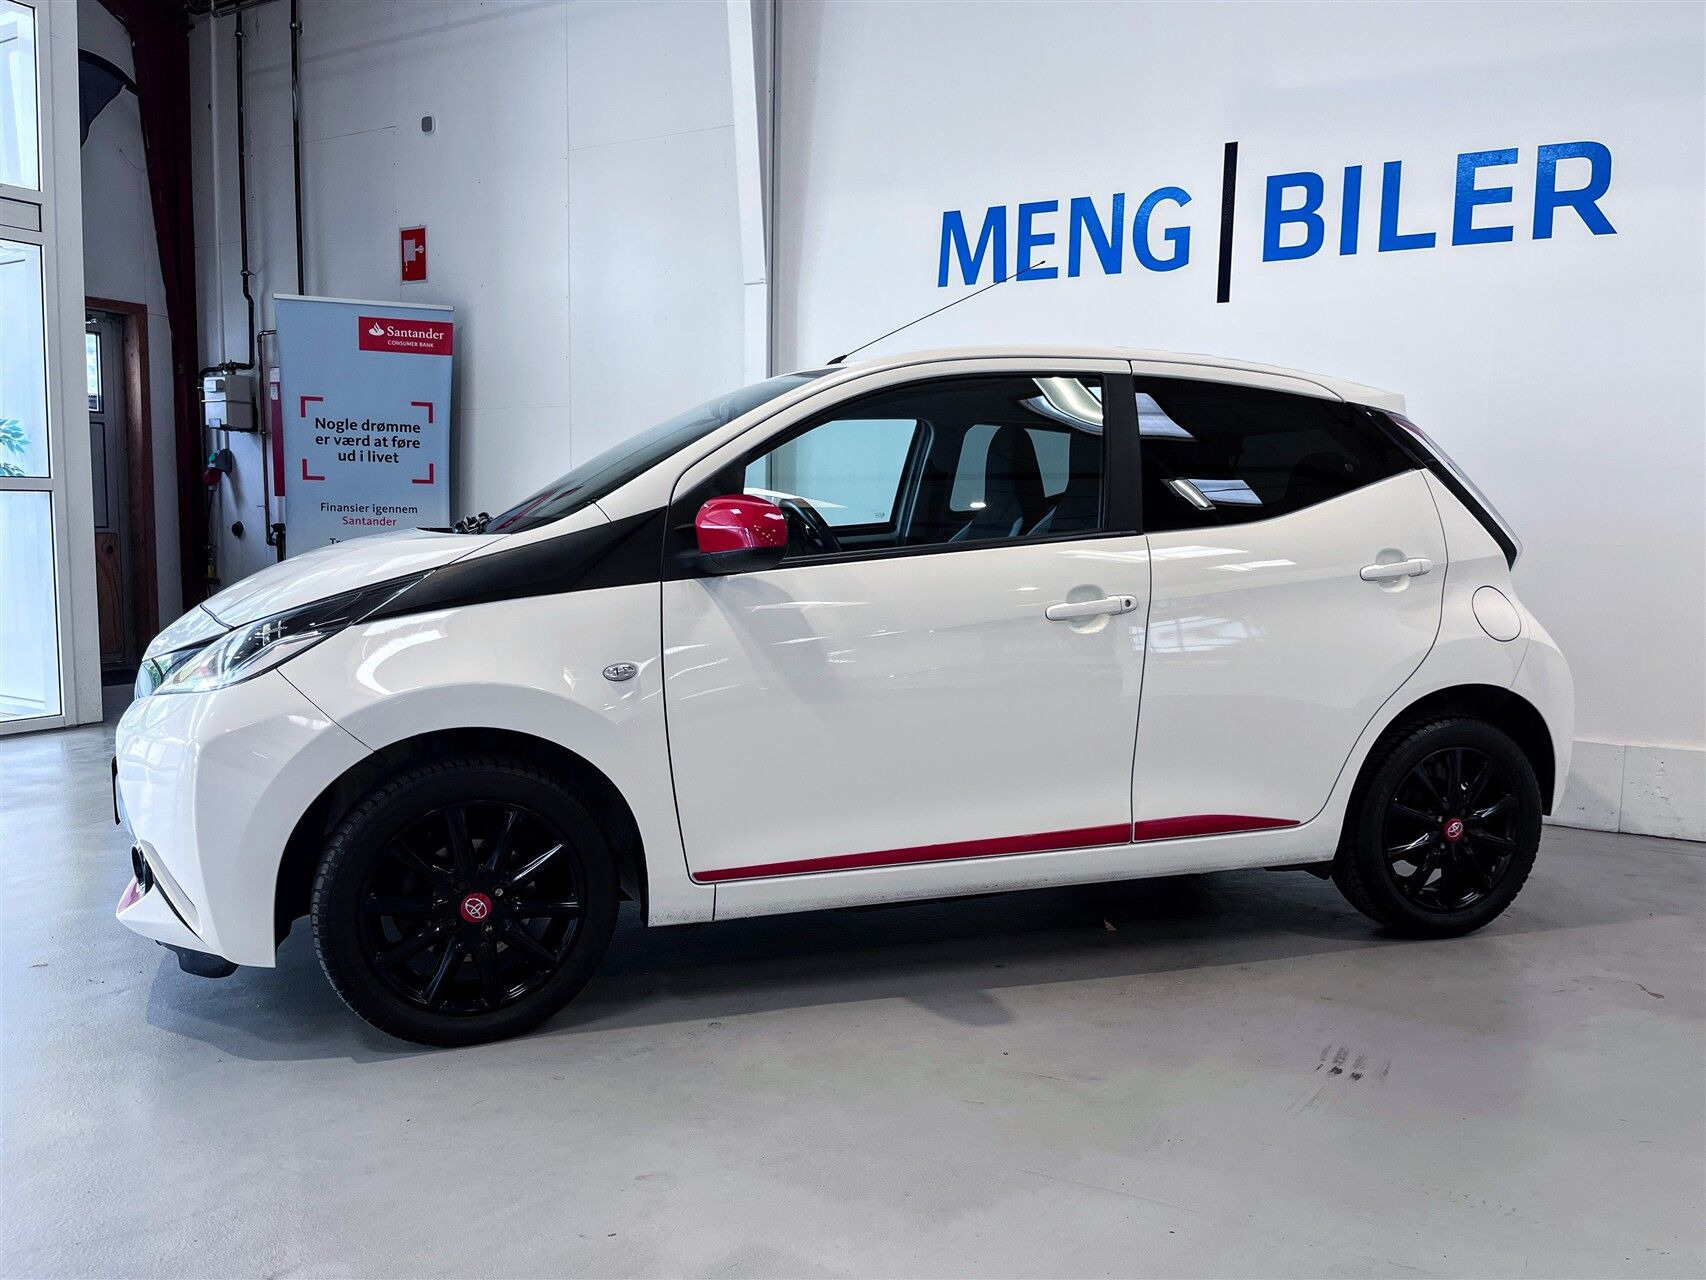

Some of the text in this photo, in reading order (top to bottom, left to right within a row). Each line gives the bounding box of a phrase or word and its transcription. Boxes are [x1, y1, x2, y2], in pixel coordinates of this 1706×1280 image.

[937, 141, 1618, 288] MENG BILER
[387, 326, 444, 340] Santander
[315, 417, 421, 433] Nogle drømme
[315, 435, 421, 449] er værd at føre
[338, 450, 399, 463] ud i livet
[320, 502, 418, 515] Finansier igennem
[342, 516, 397, 526] Santander
